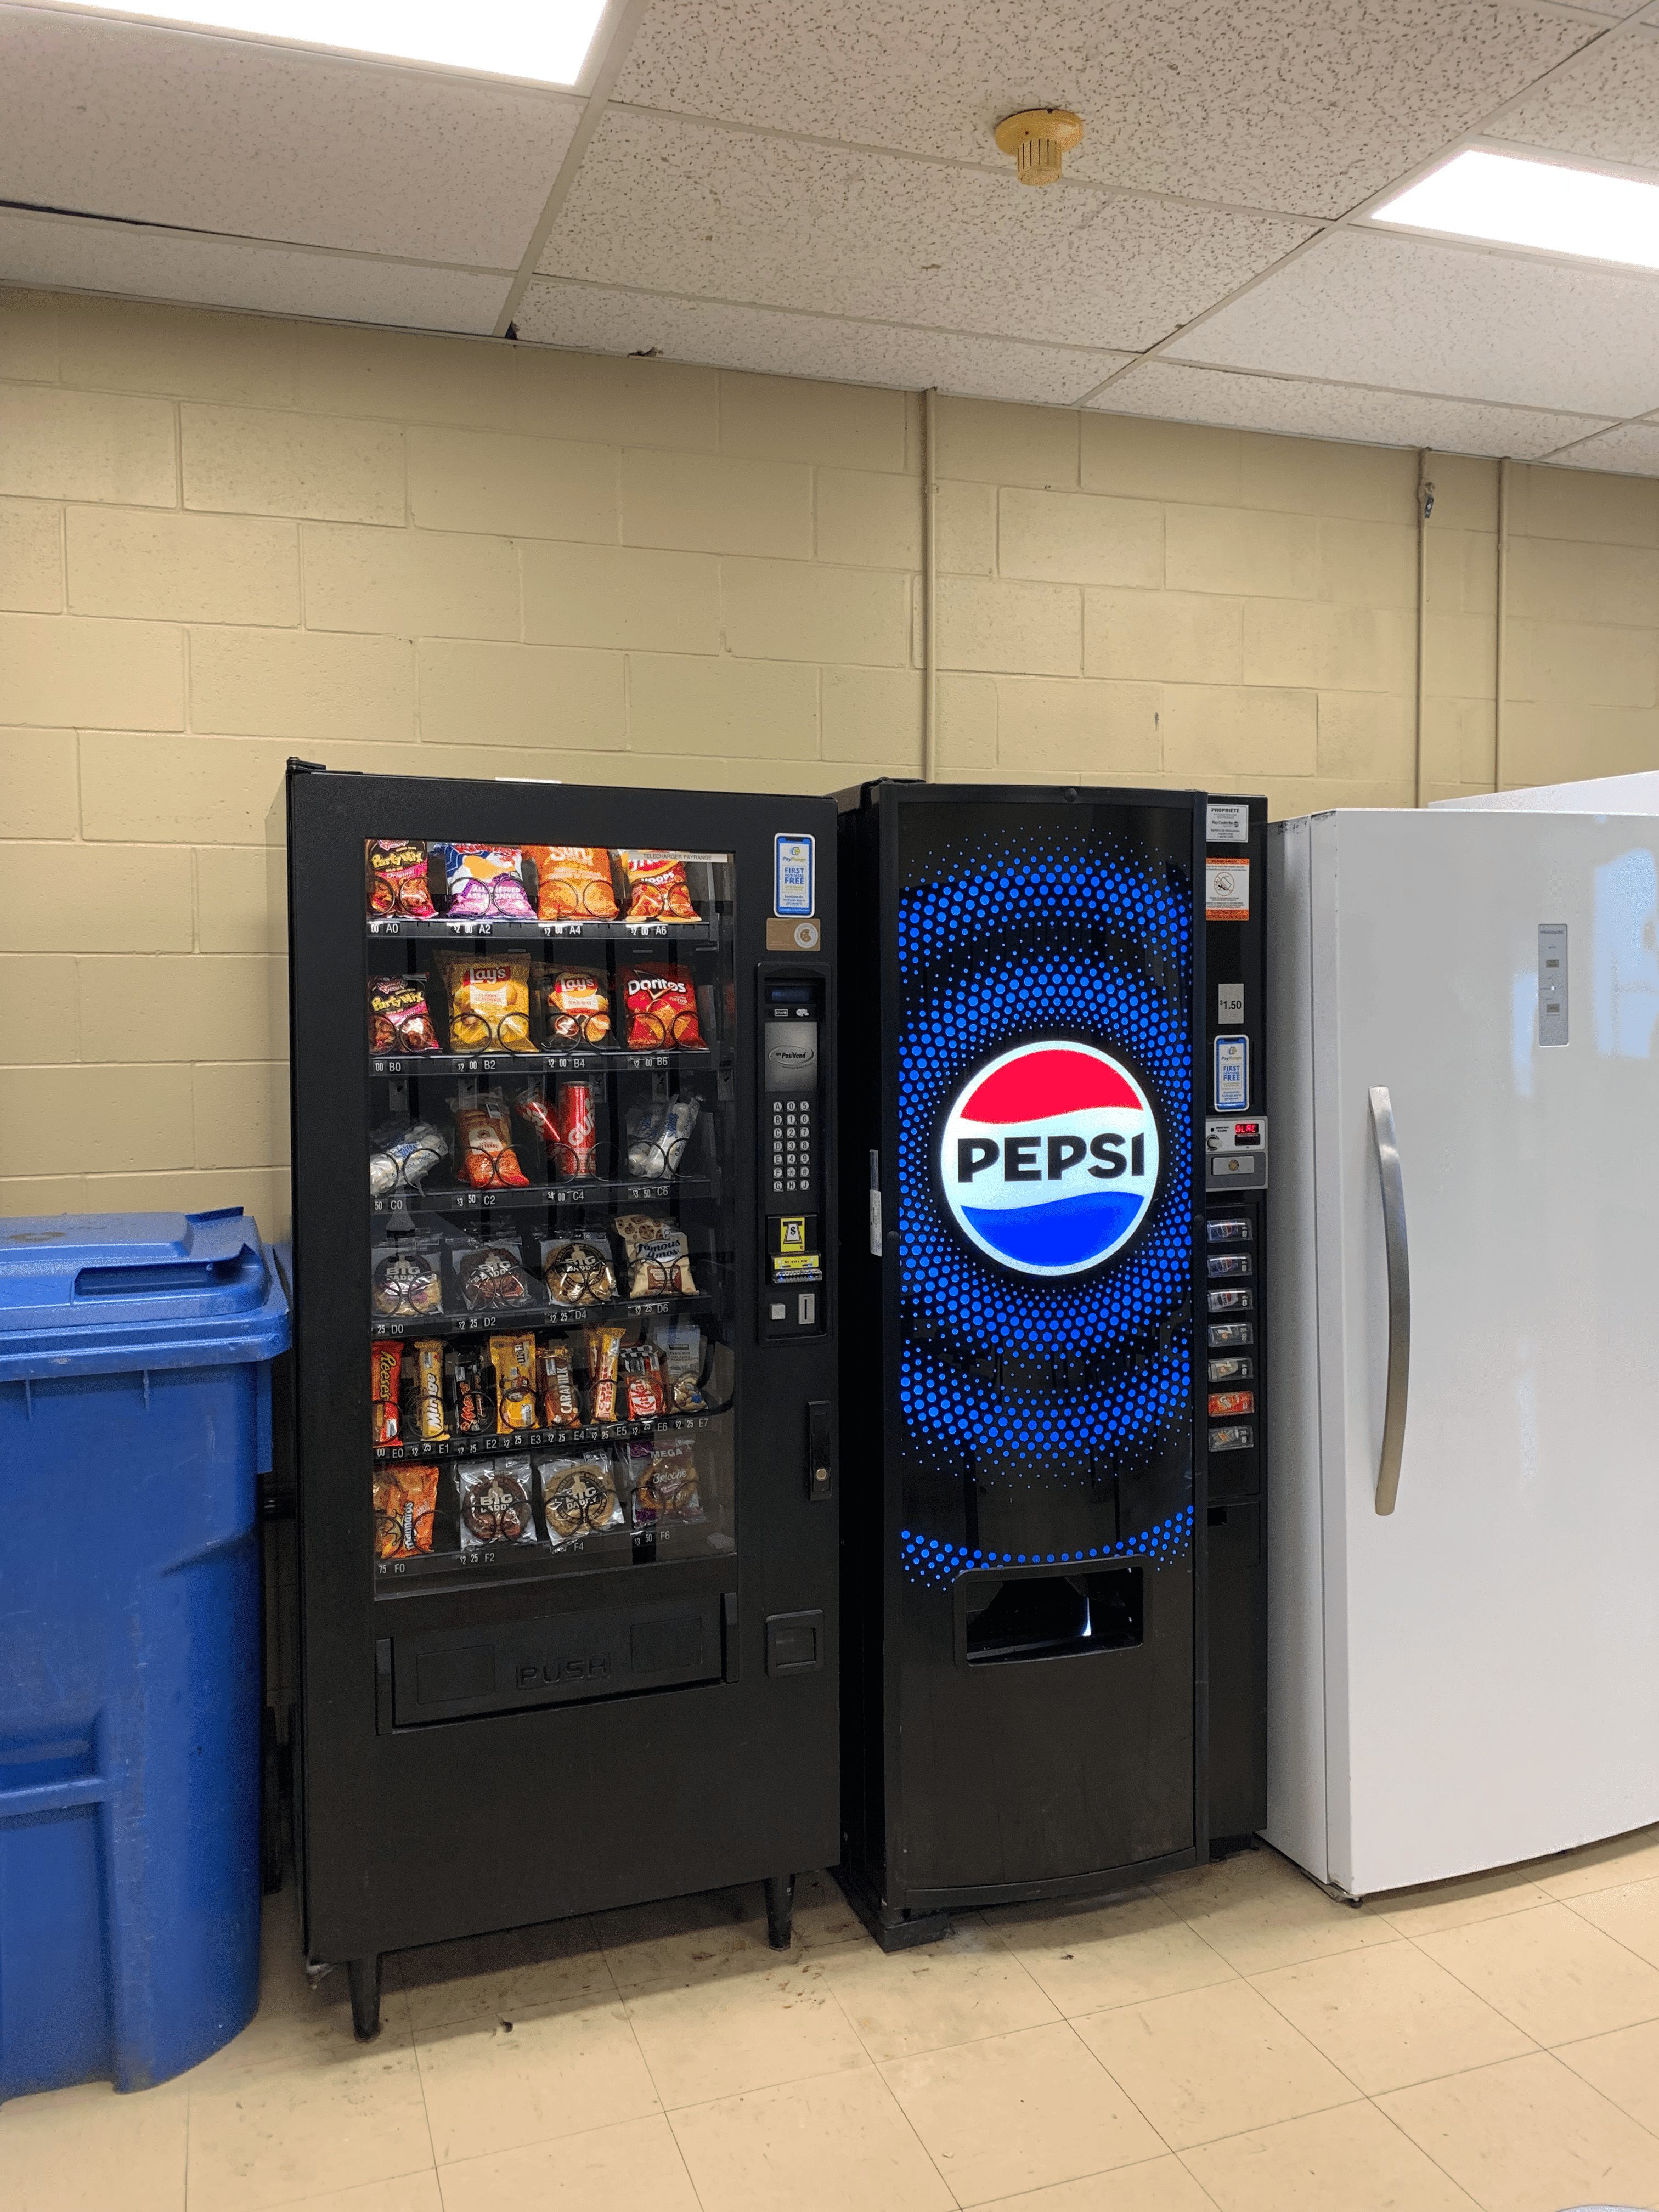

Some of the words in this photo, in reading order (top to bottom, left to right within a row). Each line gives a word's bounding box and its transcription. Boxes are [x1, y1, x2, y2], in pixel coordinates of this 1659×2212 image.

[386, 924, 398, 933] A0
[478, 924, 491, 933] A2
[569, 926, 582, 935] A4
[641, 927, 649, 936] 00
[655, 926, 667, 936] A6
[470, 967, 506, 984] Lay's
[560, 978, 593, 992] Lay's
[628, 978, 686, 995] Doritos
[1220, 1000, 1242, 1009] $1.50
[375, 1062, 384, 1071] 00
[389, 1062, 402, 1072] B0
[458, 1063, 465, 1072] $2
[470, 1061, 477, 1070] 00
[484, 1060, 496, 1069] B2
[549, 1059, 555, 1068] $2
[560, 1059, 567, 1068] 00
[574, 1059, 585, 1068] B4
[633, 1060, 640, 1068] $2
[657, 1057, 668, 1065] B6
[957, 1132, 1145, 1183] PEPSI
[558, 1193, 565, 1201] 00
[573, 1192, 584, 1200] C4
[632, 1188, 639, 1197] $3
[644, 1188, 651, 1198] 50
[657, 1186, 668, 1196] C6
[375, 1200, 383, 1210] 50
[391, 1199, 403, 1209] C0
[456, 1197, 464, 1207] $3
[469, 1194, 476, 1204] 50
[484, 1195, 496, 1205] C2
[637, 1239, 680, 1253] Famous
[646, 1249, 678, 1259] Amos
[386, 1266, 420, 1276] BIG
[635, 1307, 641, 1316] $2
[657, 1304, 669, 1313] D6
[550, 1314, 557, 1323] $2
[561, 1312, 568, 1321] 25
[576, 1310, 587, 1319] D4
[377, 1324, 386, 1334] 25
[392, 1324, 404, 1334] D0
[459, 1321, 465, 1330] $2
[470, 1319, 478, 1328] 25
[484, 1318, 496, 1327] D2
[381, 1351, 397, 1400] Reese's
[632, 1427, 639, 1436] $2
[644, 1422, 651, 1430] 25
[657, 1423, 668, 1432] E6
[675, 1421, 681, 1430] $2
[687, 1420, 694, 1428] 25
[699, 1419, 709, 1427] E7
[548, 1434, 554, 1442] $2
[558, 1434, 566, 1442] 25
[574, 1431, 585, 1440] E4
[591, 1432, 597, 1441] $2
[601, 1431, 609, 1439] 25
[617, 1427, 627, 1436] E5
[504, 1440, 510, 1448] $2
[515, 1436, 522, 1444] 25
[530, 1435, 541, 1444] E3
[392, 1448, 404, 1458] E0
[411, 1447, 419, 1456] $2
[424, 1443, 431, 1452] 25
[439, 1444, 449, 1454] E1
[458, 1446, 464, 1455] $2
[486, 1440, 497, 1449] E2
[651, 1448, 683, 1459] MEGA
[480, 1493, 513, 1505] BIG
[634, 1537, 641, 1546] $3
[645, 1534, 653, 1543] 50
[661, 1531, 670, 1541] F6
[574, 1543, 584, 1551] F4
[460, 1555, 466, 1564] $2
[471, 1554, 478, 1562] 25
[485, 1553, 495, 1562] F2
[379, 1565, 387, 1573] 75
[395, 1564, 405, 1573] F0
[521, 1658, 606, 1688] PUSH
